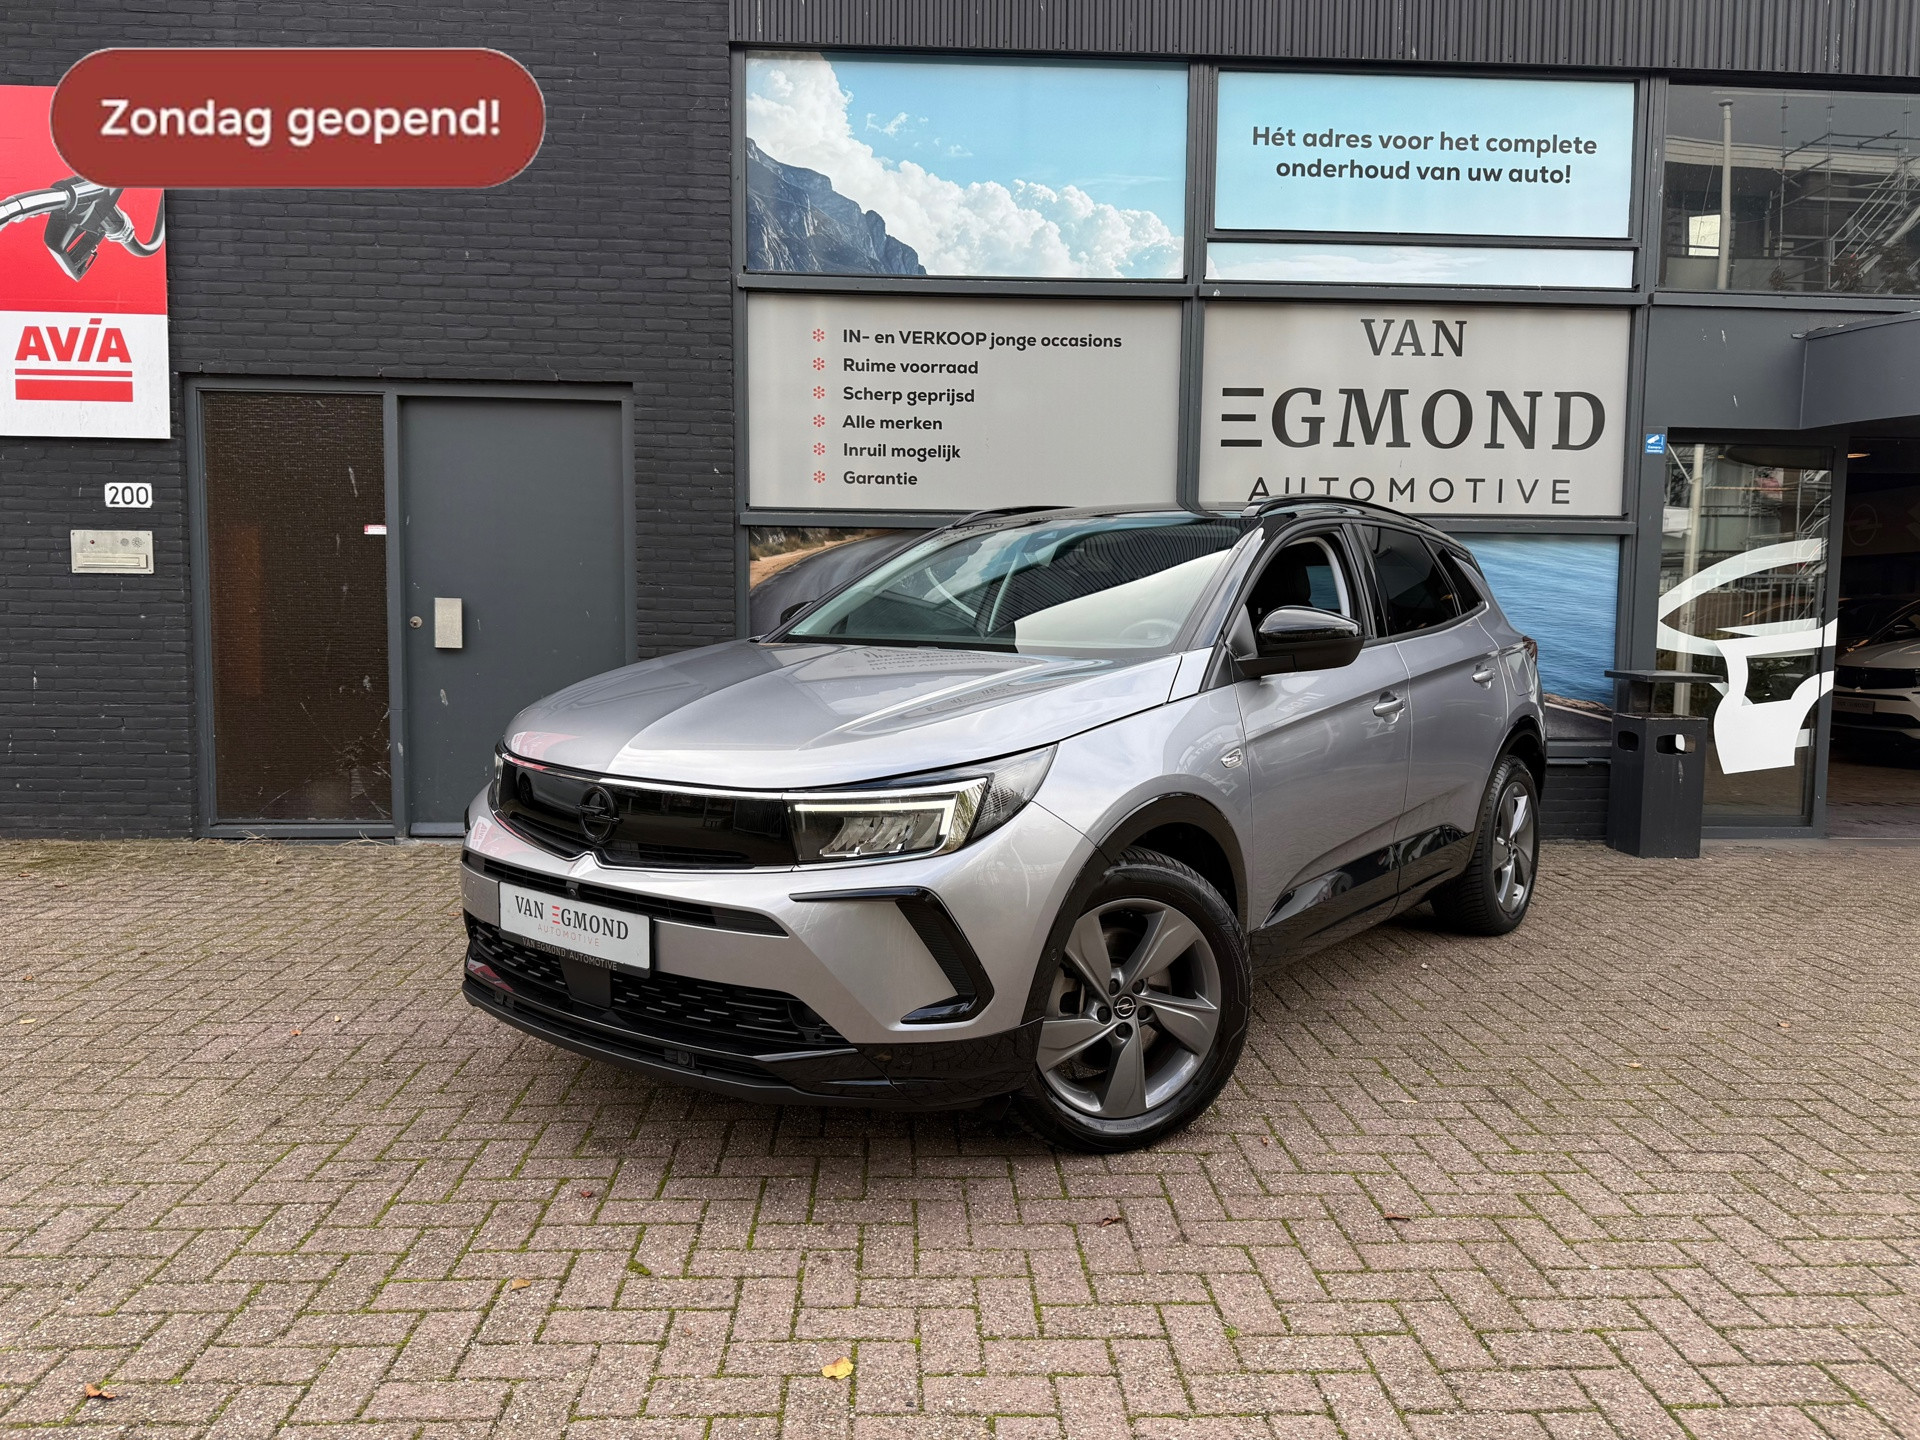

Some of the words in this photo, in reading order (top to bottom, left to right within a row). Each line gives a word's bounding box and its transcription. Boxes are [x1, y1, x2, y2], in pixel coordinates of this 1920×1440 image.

[1252, 126, 1296, 147] Hét
[1302, 129, 1373, 149] adres
[1378, 134, 1434, 150] voor
[1439, 131, 1480, 152] het
[1485, 134, 1598, 158] complete
[1275, 159, 1410, 180] onderhoud
[1416, 166, 1461, 181] van
[1467, 167, 1503, 182] uw
[1508, 165, 1571, 184] auto!
[15, 318, 133, 363] AVIA
[843, 329, 870, 344] IN-
[874, 333, 895, 345] en
[899, 331, 987, 346] VERKOOP
[989, 333, 1037, 351] jonge
[1041, 334, 1122, 348] occasions
[1361, 319, 1467, 357] VAN
[843, 358, 896, 373] Ruime
[900, 361, 979, 375] voorraad
[843, 387, 903, 405] Scherp
[907, 389, 975, 407] geprijsd
[843, 415, 876, 429] Alle
[880, 417, 943, 430] merken
[1220, 387, 1606, 451] EGMOND
[843, 443, 887, 457] Inruil
[891, 445, 961, 462] mogelijk
[843, 471, 918, 486] Garantie
[108, 486, 149, 505] 200
[1248, 477, 1571, 505] AUTOMOTIVE
[515, 895, 544, 920] VAN
[552, 905, 629, 940] EGMOND
[538, 923, 600, 947] AUTOMOTIVE
[522, 937, 535, 948] VAN
[569, 951, 618, 971] AUTOMOTIVE
